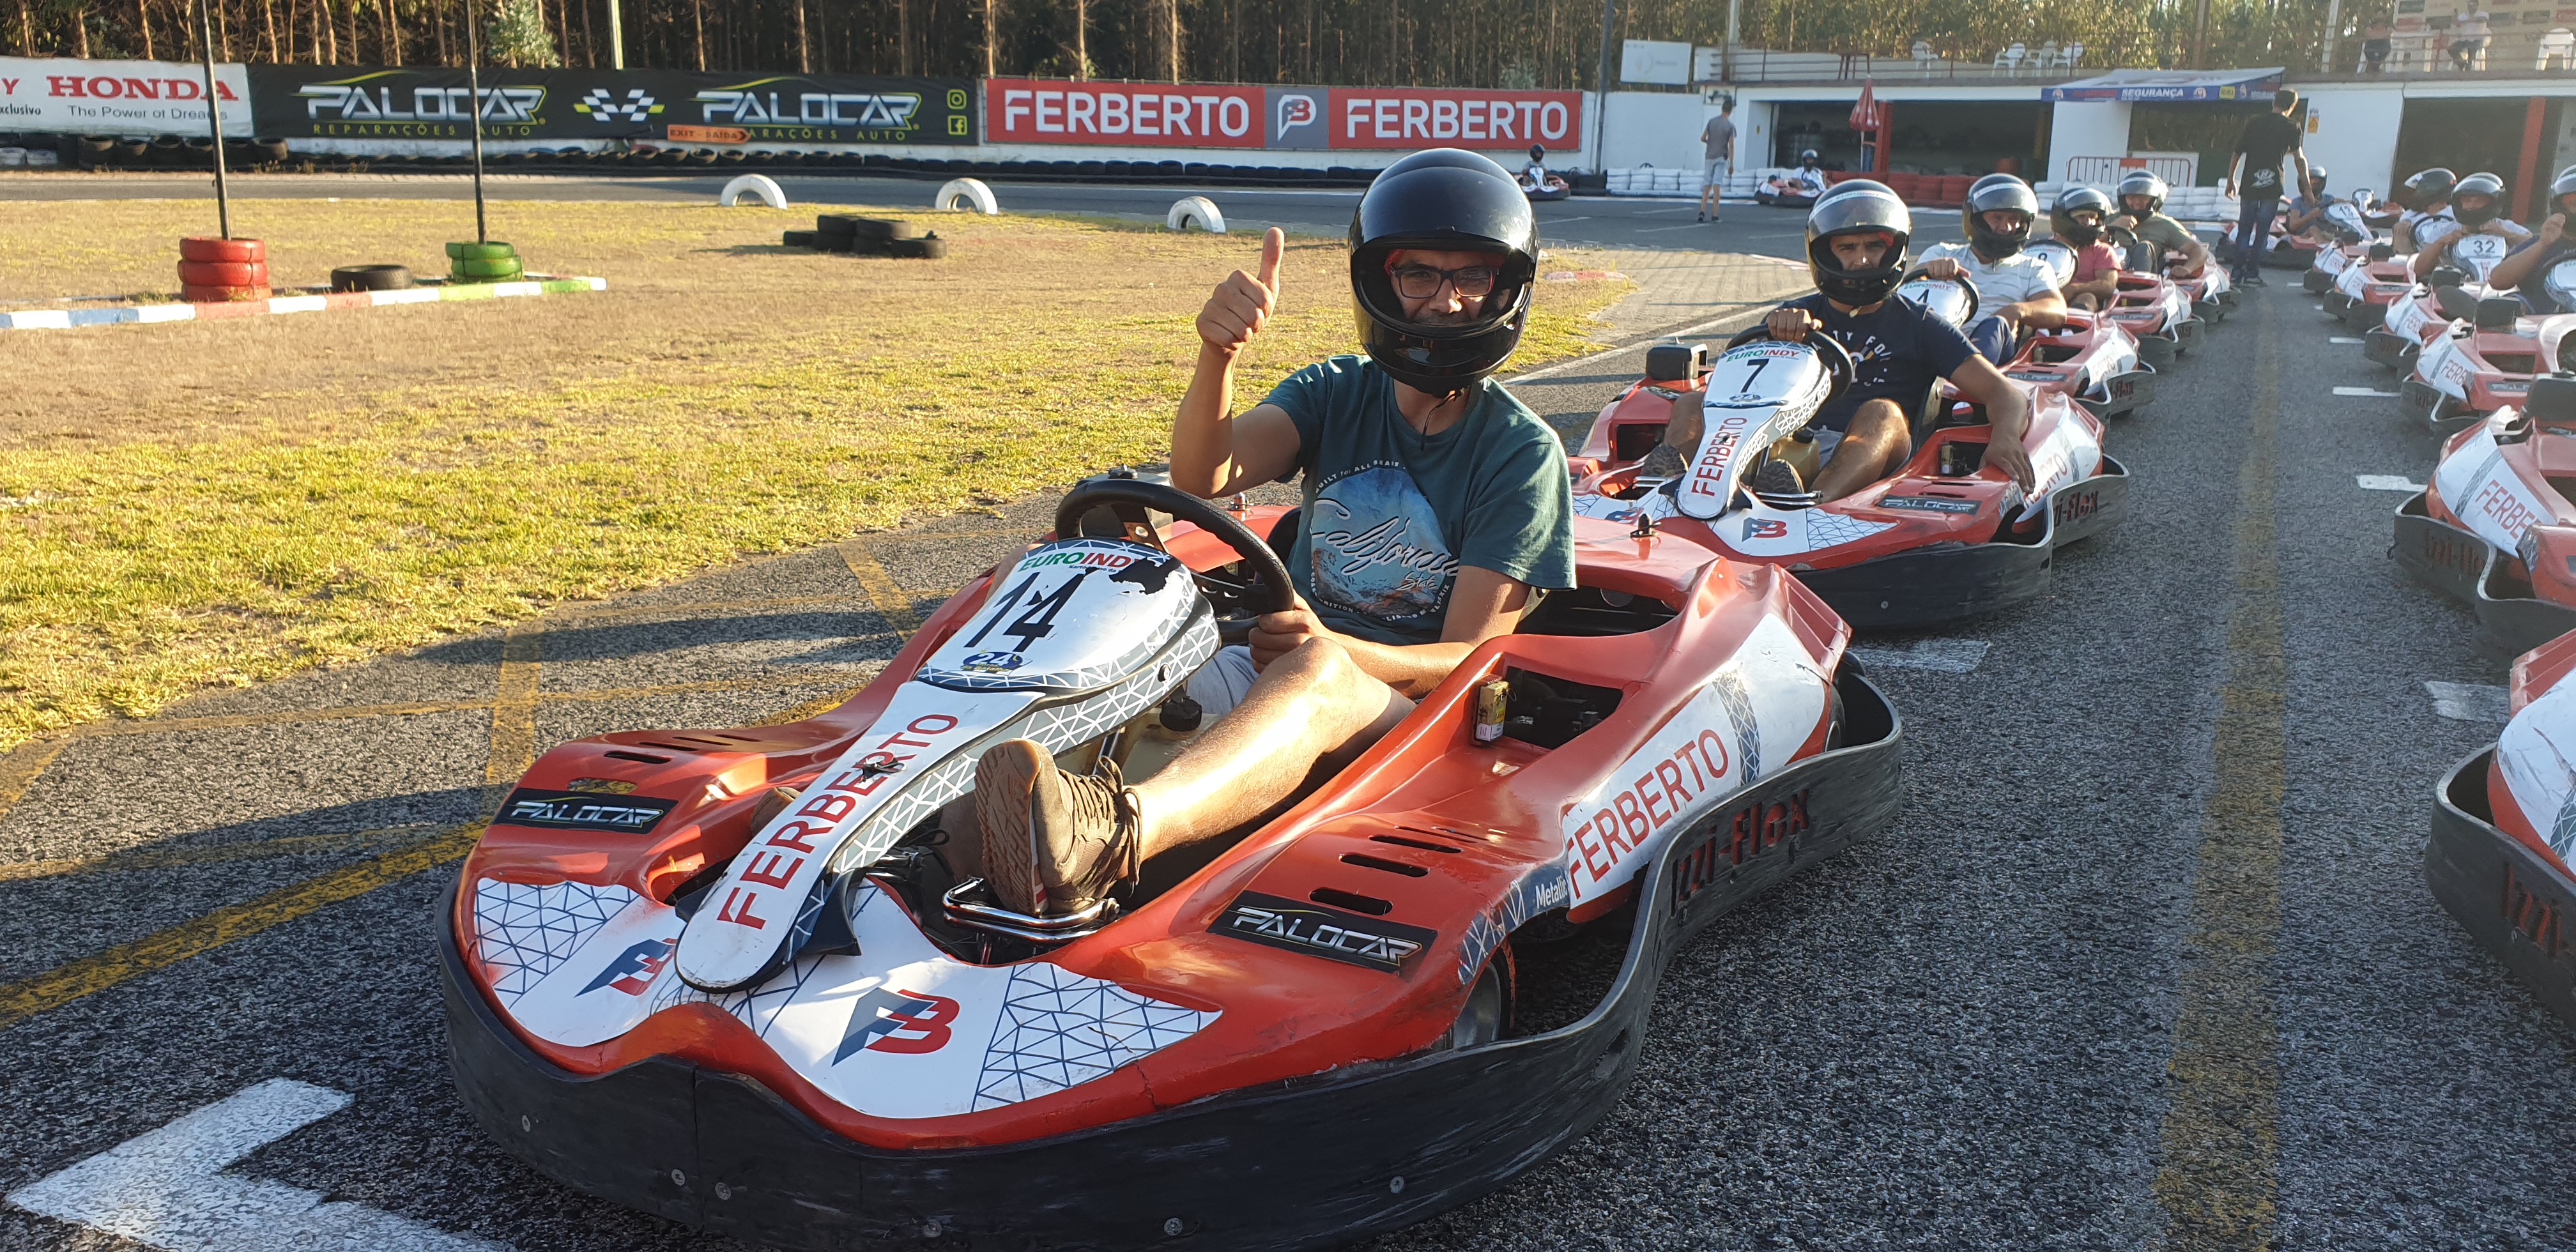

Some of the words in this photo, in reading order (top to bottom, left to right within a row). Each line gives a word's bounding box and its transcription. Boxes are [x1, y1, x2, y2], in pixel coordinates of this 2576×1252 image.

[46, 75, 239, 102] HONDA
[2121, 88, 2184, 100] SEGURANÇA
[68, 104, 97, 118] The
[102, 106, 148, 119] Power
[152, 109, 167, 119] of
[171, 107, 228, 120] Dreas
[298, 84, 546, 121] PALOCAR
[696, 90, 920, 126] PALOCAR
[1004, 88, 1250, 137] FERBERTO
[312, 122, 456, 137] REPARAÇÕES
[479, 124, 531, 136] AUTO
[1347, 98, 1568, 141] FERBERTO
[670, 129, 696, 137] EXIT
[748, 125, 838, 140] ARAÇÕES
[856, 130, 907, 142] AUTO
[2472, 240, 2496, 254] 32
[1726, 349, 1800, 363] EUROINDY
[1740, 358, 1770, 393] 7
[1354, 463, 1372, 472] ALL
[1690, 416, 1748, 496] FERBERTO
[1883, 498, 1978, 512] PALOCAR
[2474, 479, 2541, 540] FERBE
[1017, 551, 1141, 572] EUROIND
[963, 570, 1085, 653] 14
[969, 652, 1015, 666] 24
[510, 800, 663, 826] PALOCAR
[716, 713, 960, 930] FERBERTO
[1567, 728, 1729, 901] FERBERTO
[1232, 906, 1420, 962] PALOCAR
